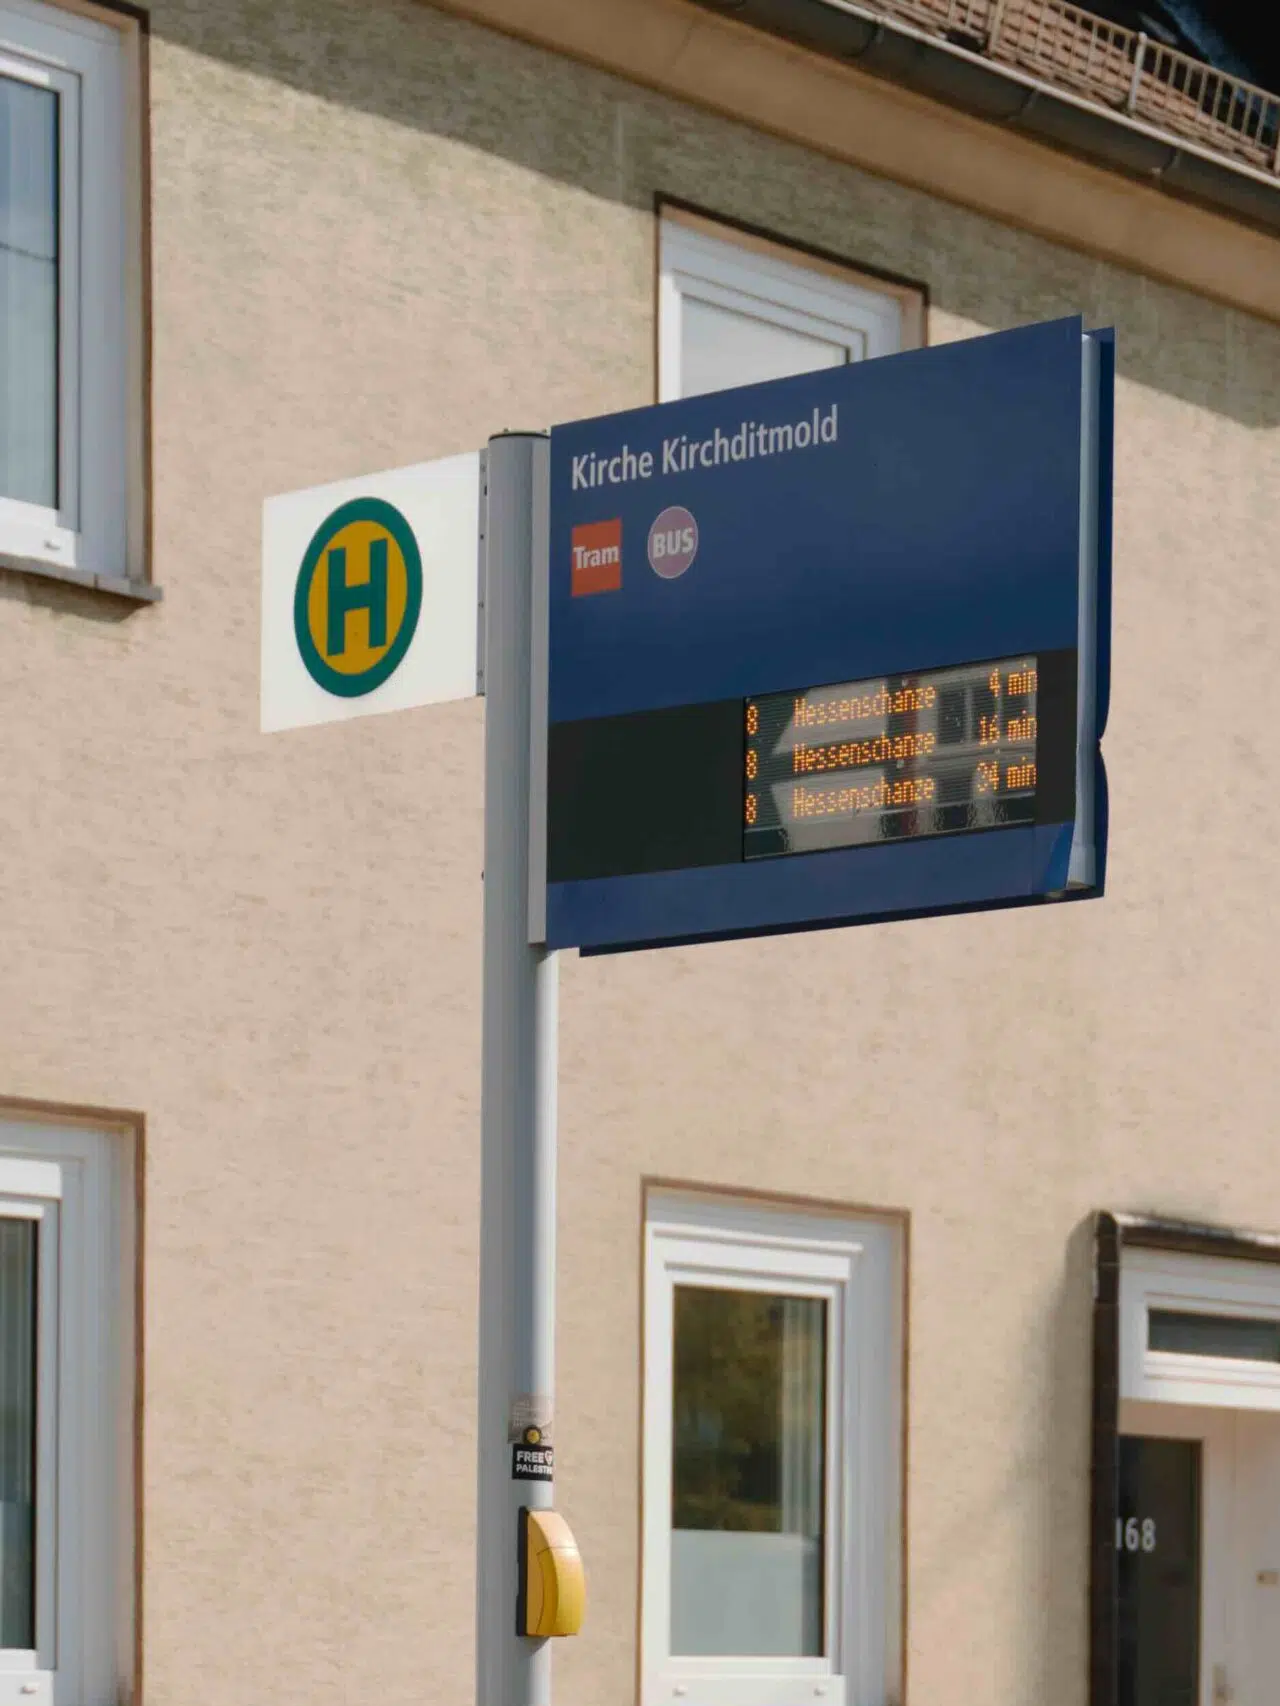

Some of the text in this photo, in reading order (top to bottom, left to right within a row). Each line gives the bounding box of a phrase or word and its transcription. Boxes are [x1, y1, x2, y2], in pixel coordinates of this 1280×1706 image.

[571, 404, 839, 491] Kirche Kirchditmold
[573, 543, 620, 570] Tram
[652, 527, 694, 559] BUS
[327, 538, 388, 656] H
[746, 662, 1037, 736] 8 Hessenschanze 4 min
[746, 709, 1037, 781] 8 Hessenschanze 16 min
[745, 794, 757, 824] 8
[792, 773, 934, 818] Hessenschanze
[1006, 756, 1037, 789] min
[516, 1450, 545, 1464] FREE
[1115, 1516, 1156, 1551] 168
